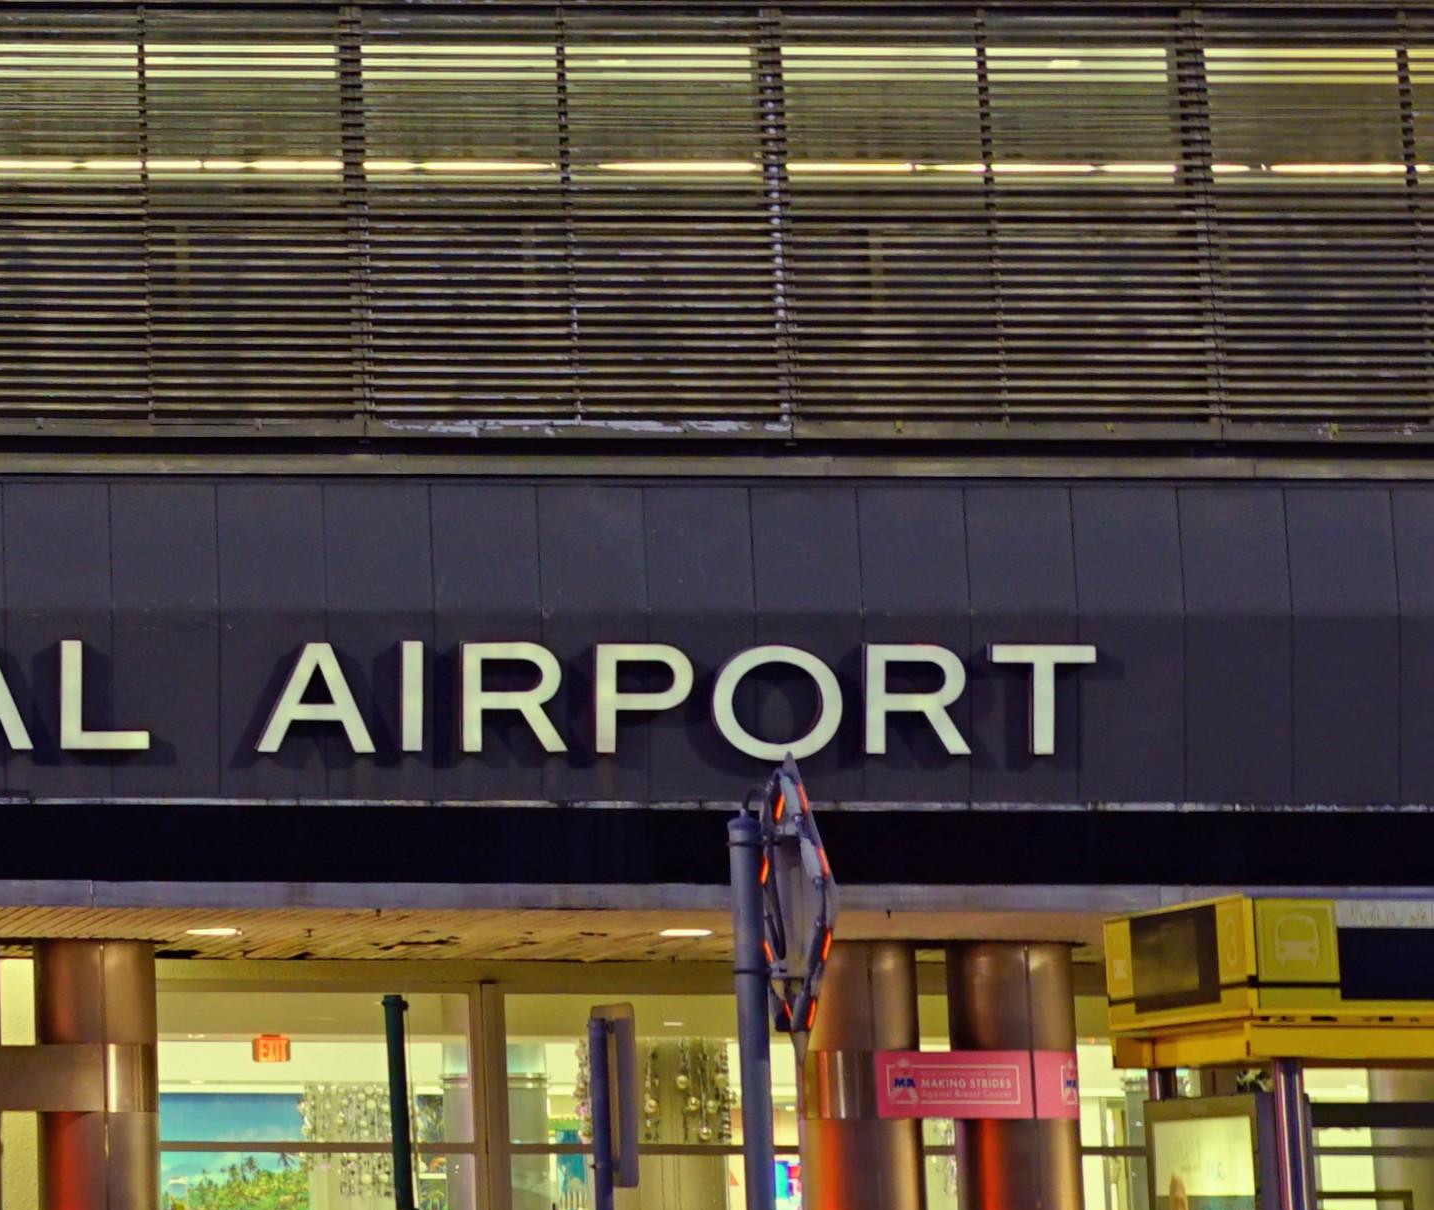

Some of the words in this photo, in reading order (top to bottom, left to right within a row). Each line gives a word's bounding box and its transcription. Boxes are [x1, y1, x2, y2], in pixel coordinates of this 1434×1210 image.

[257, 639, 1098, 762] AIRPORT
[258, 1040, 288, 1061] EXIT
[921, 1078, 966, 1089] MAKING
[970, 1078, 1012, 1089] STRIDES
